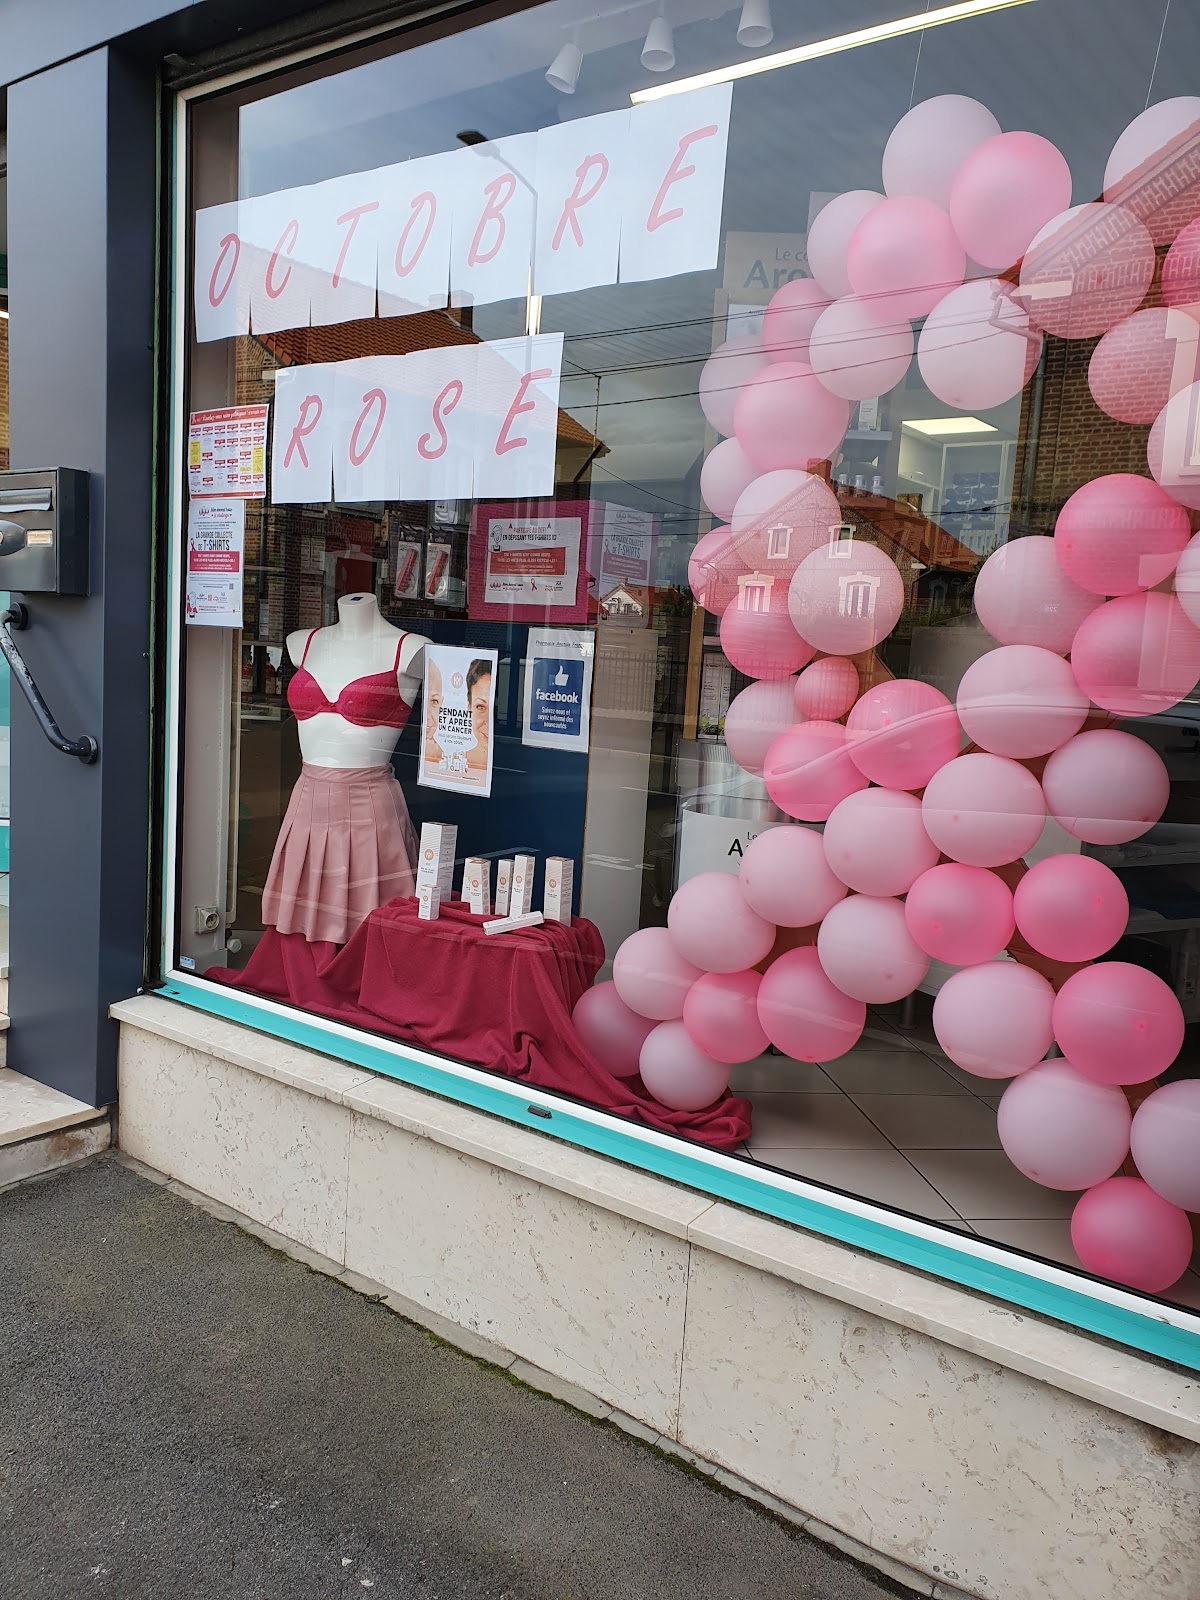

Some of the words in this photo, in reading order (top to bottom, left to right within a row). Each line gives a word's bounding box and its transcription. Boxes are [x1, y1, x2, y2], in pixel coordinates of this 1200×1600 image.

[208, 124, 719, 308] OCTOBRE
[775, 247, 791, 261] Le
[283, 367, 552, 469] ROSE
[203, 539, 230, 551] T-SHIRTS
[535, 688, 579, 703] facebook
[438, 706, 473, 719] PENDANT
[438, 715, 447, 724] ET
[438, 723, 447, 731] UN
[447, 725, 472, 735] CANCER
